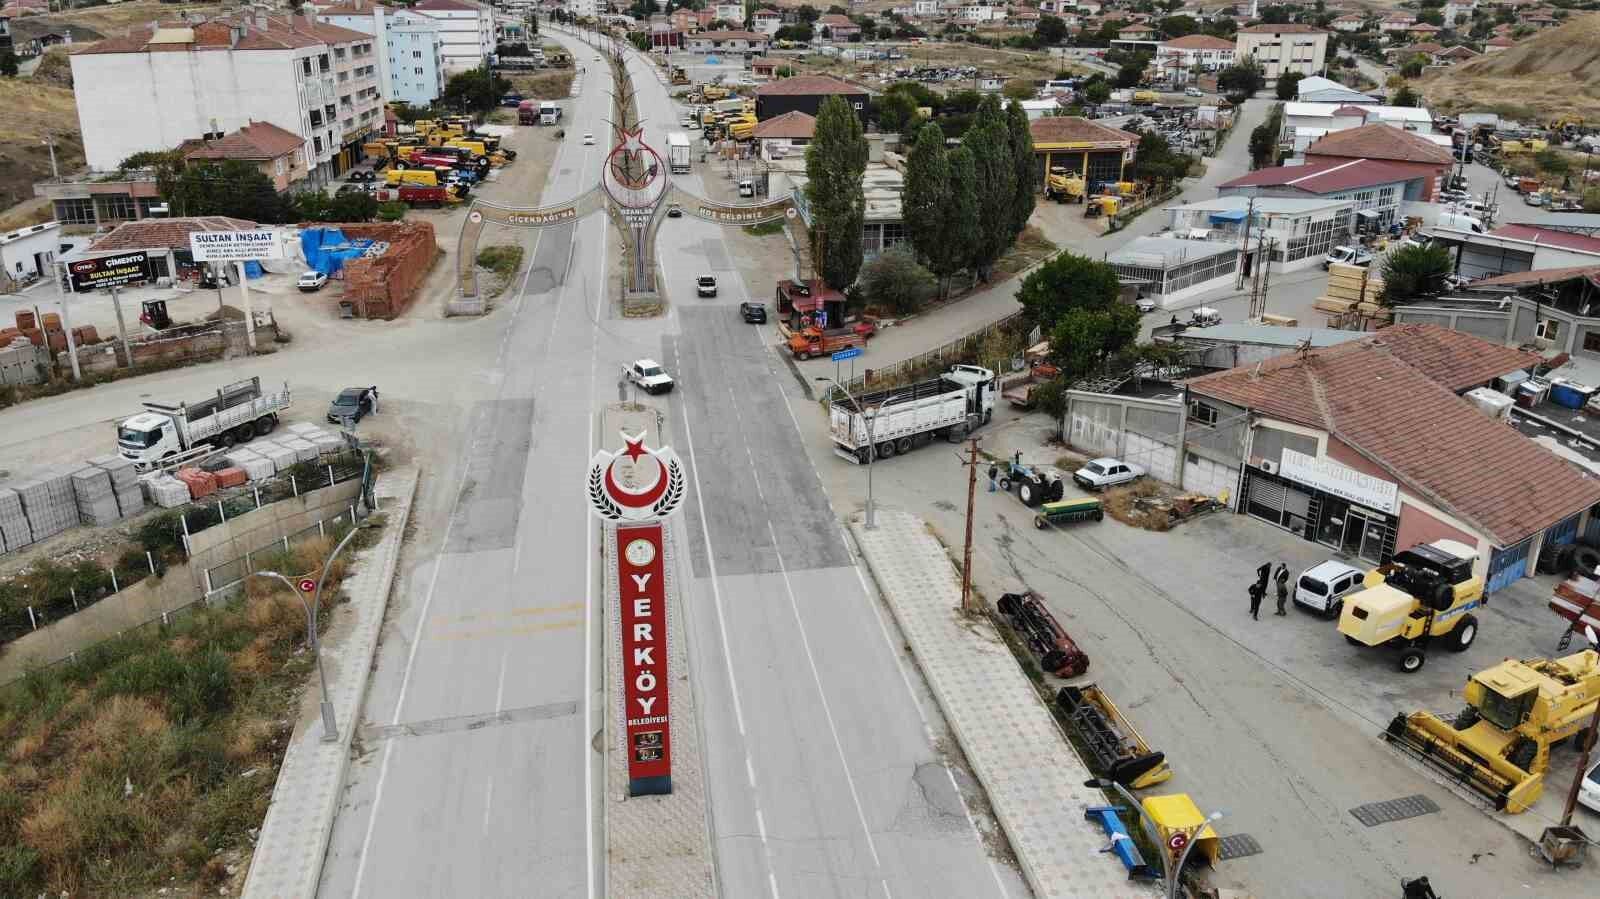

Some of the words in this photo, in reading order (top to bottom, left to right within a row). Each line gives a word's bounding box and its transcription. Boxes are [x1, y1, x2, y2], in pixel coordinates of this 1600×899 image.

[195, 234, 232, 242] SULTAN
[90, 269, 116, 279] SULTAN
[630, 573, 657, 715] YERKÖY
[628, 715, 667, 726] BELEDİYESİ
